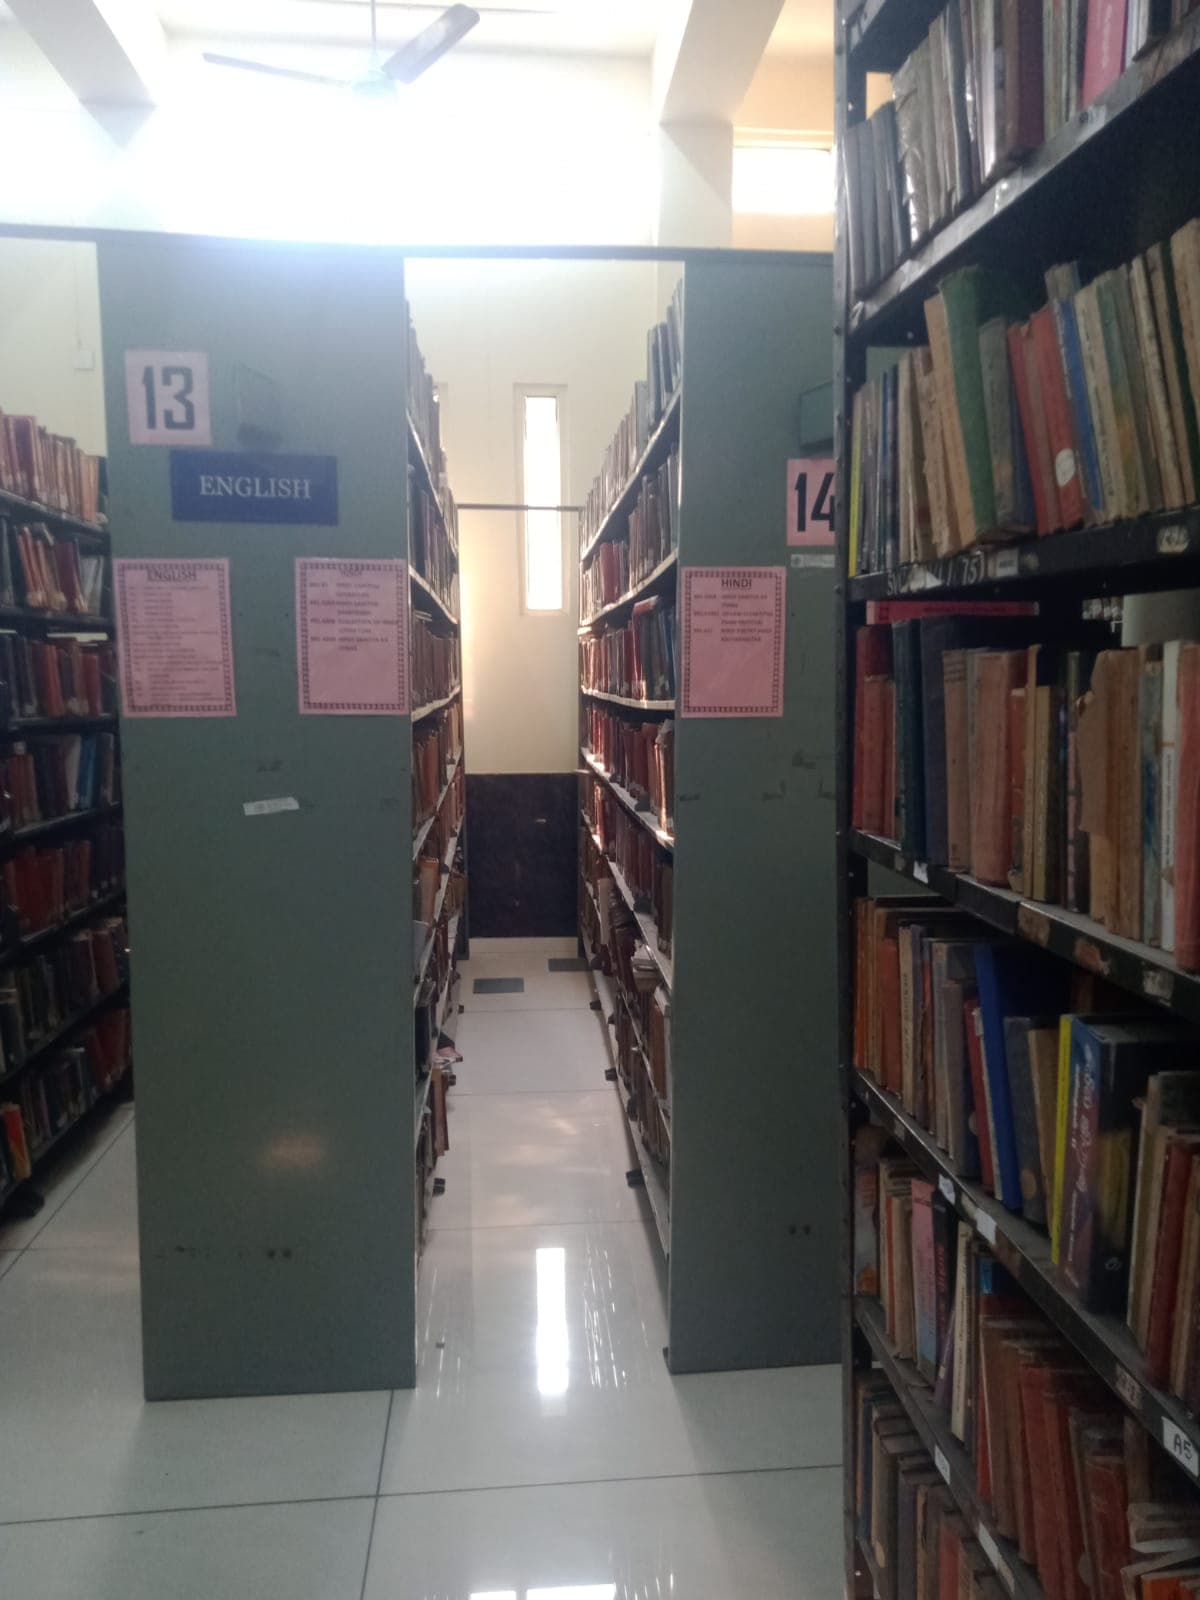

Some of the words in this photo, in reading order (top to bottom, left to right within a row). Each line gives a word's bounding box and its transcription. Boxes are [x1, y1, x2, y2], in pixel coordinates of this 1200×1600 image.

[142, 366, 195, 430] 13
[200, 475, 311, 499] ENGLISH
[795, 472, 836, 531] 14
[721, 578, 752, 588] HINDI
[1174, 1433, 1193, 1460] A5
